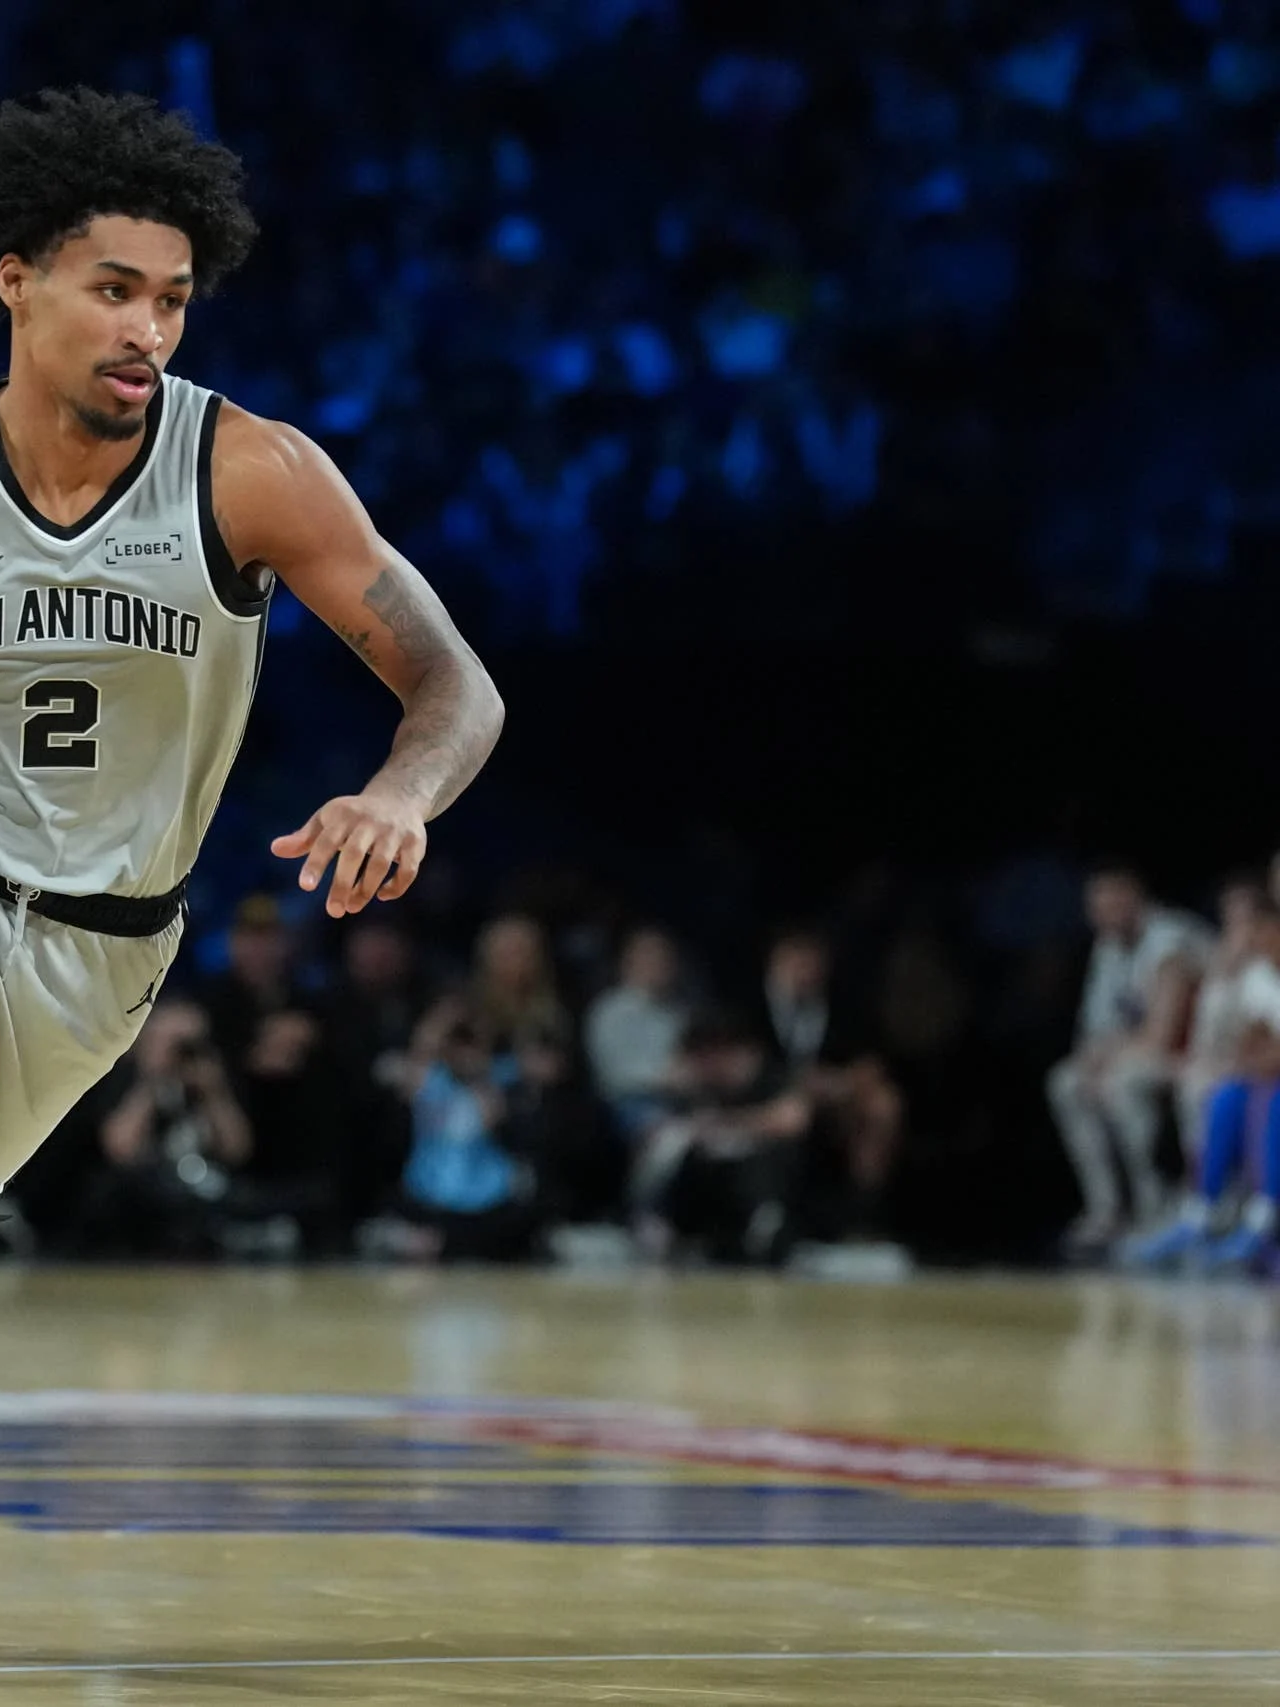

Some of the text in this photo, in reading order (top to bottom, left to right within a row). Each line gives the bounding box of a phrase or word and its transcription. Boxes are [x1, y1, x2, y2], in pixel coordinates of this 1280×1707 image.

[115, 542, 172, 557] LEDGER
[14, 586, 201, 660] ANTONIO
[20, 678, 101, 771] 2
